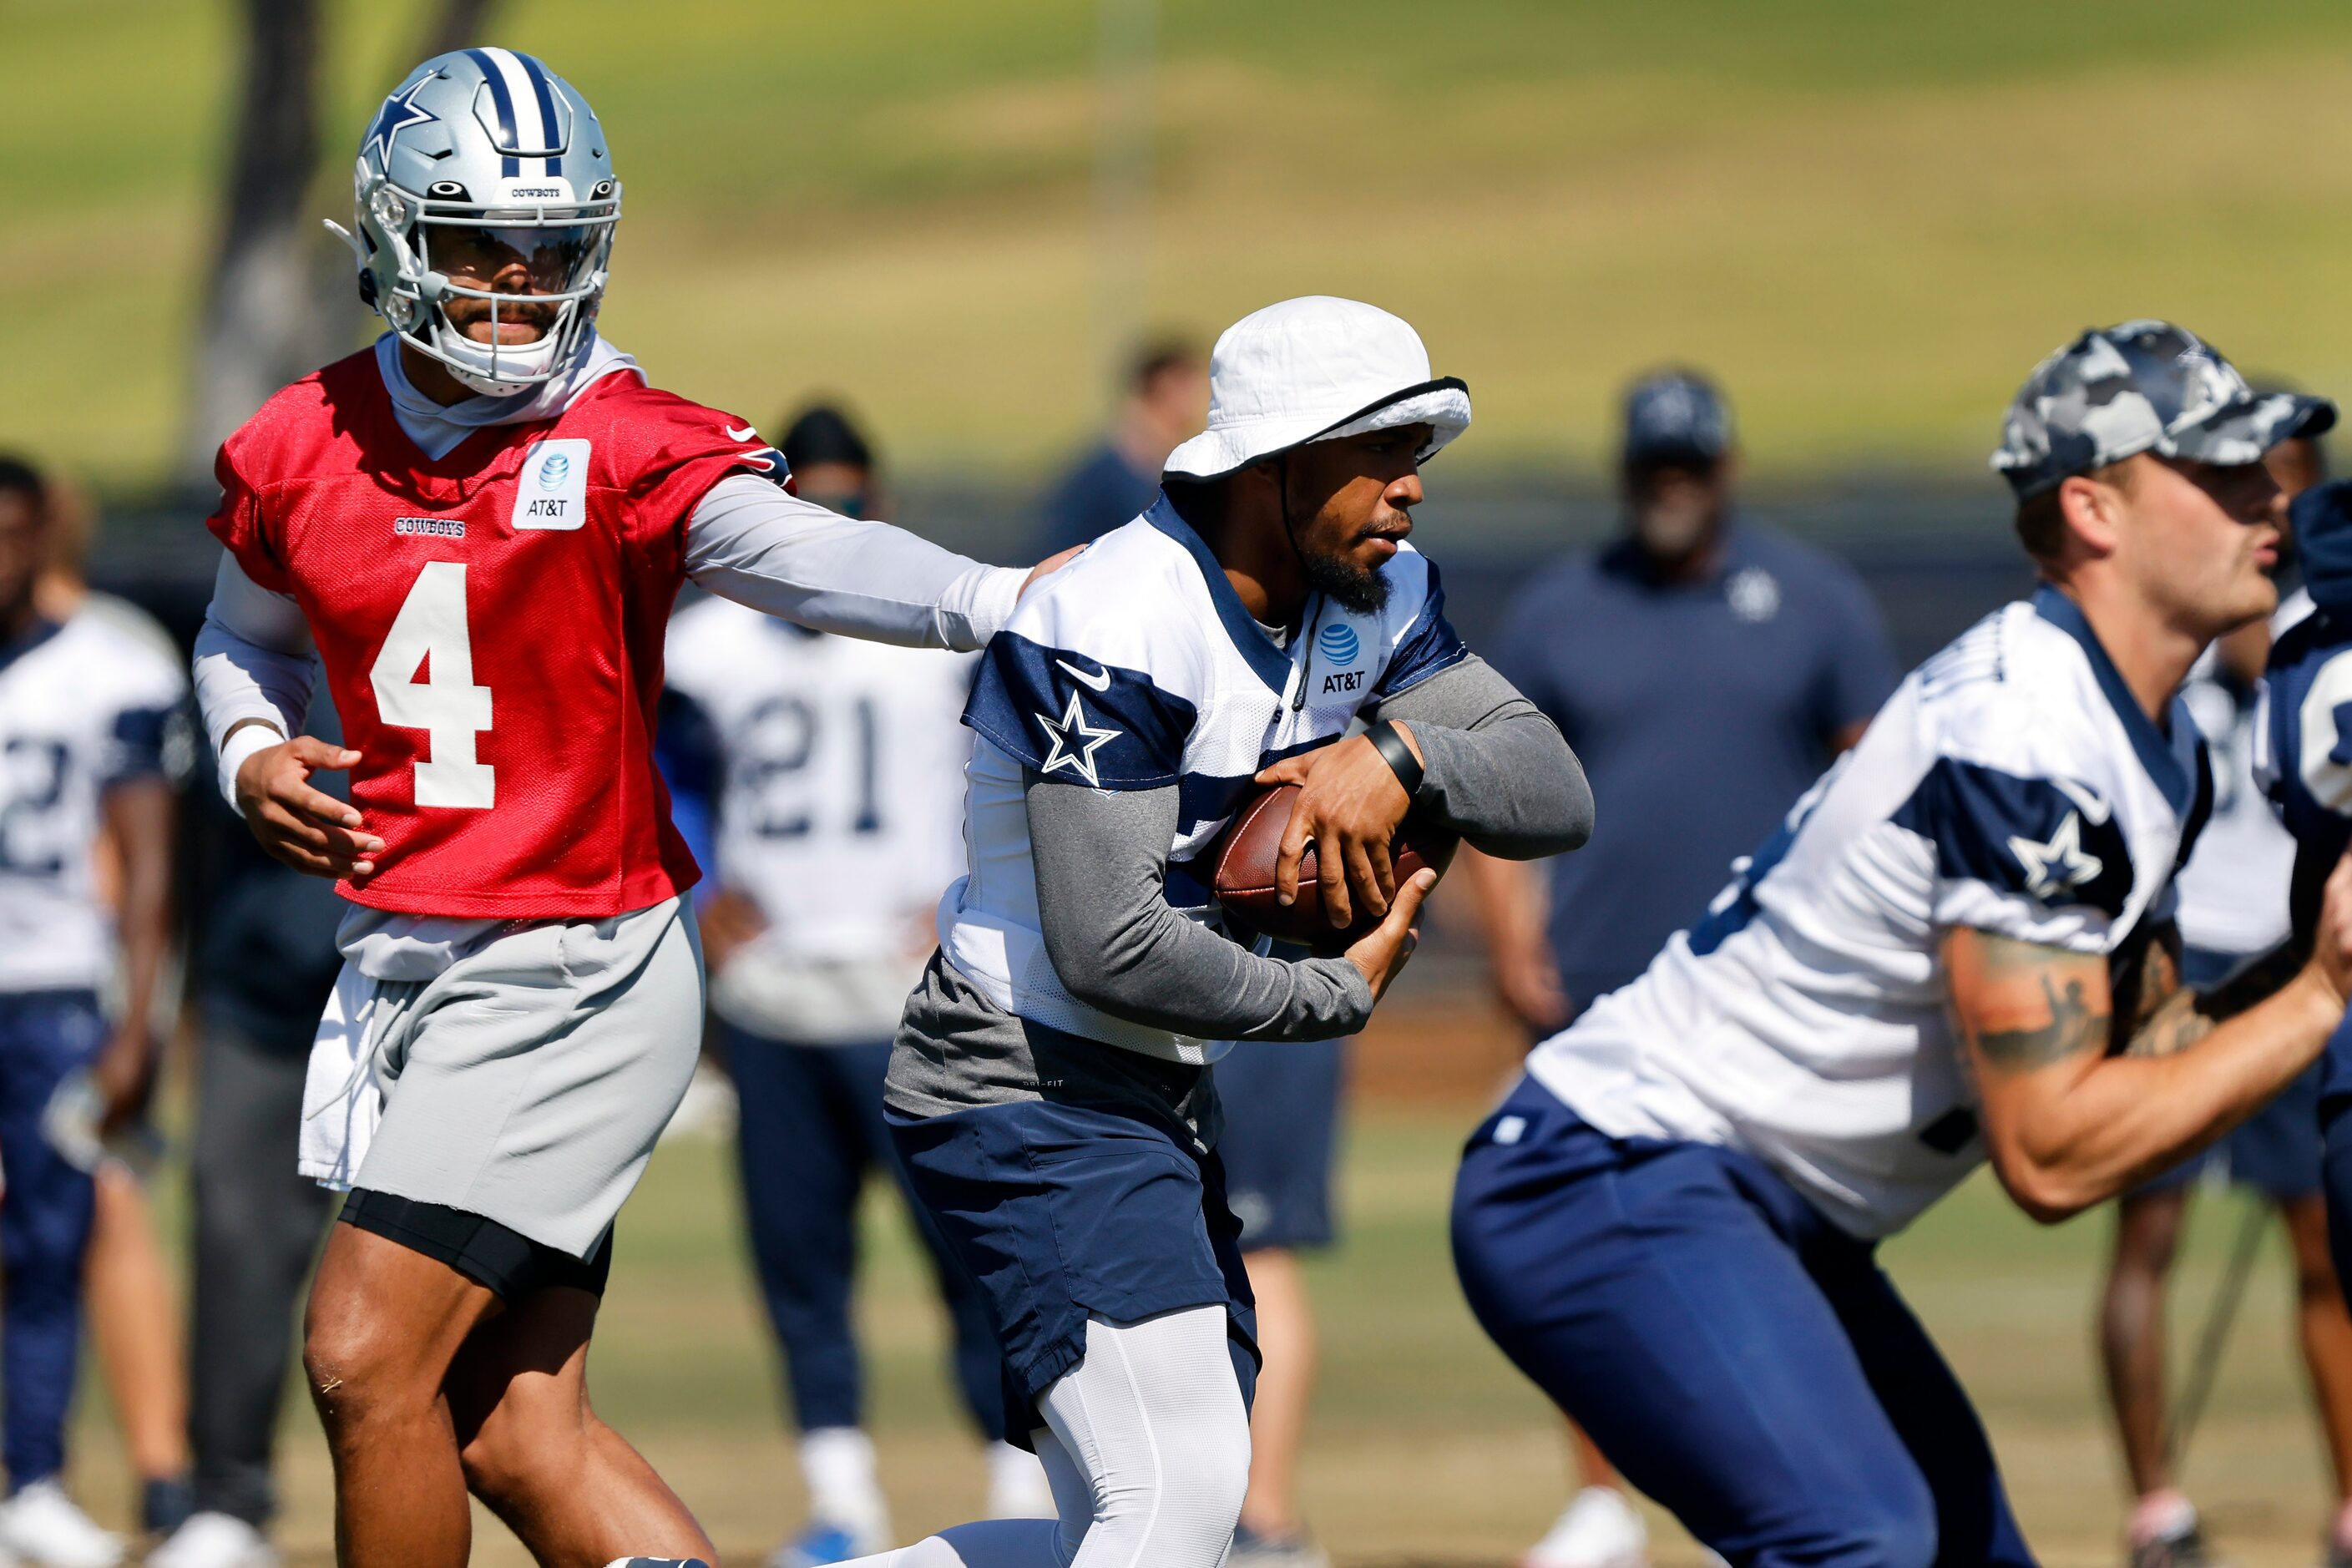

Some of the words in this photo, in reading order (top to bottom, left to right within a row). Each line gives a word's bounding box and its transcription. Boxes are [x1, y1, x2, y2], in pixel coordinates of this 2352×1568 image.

[512, 189, 560, 197] COWBOYS
[526, 499, 568, 516] AT&T
[395, 517, 466, 538] COWBOYS
[369, 561, 495, 809] 4
[1323, 670, 1365, 694] AT&T
[740, 695, 882, 837] 21
